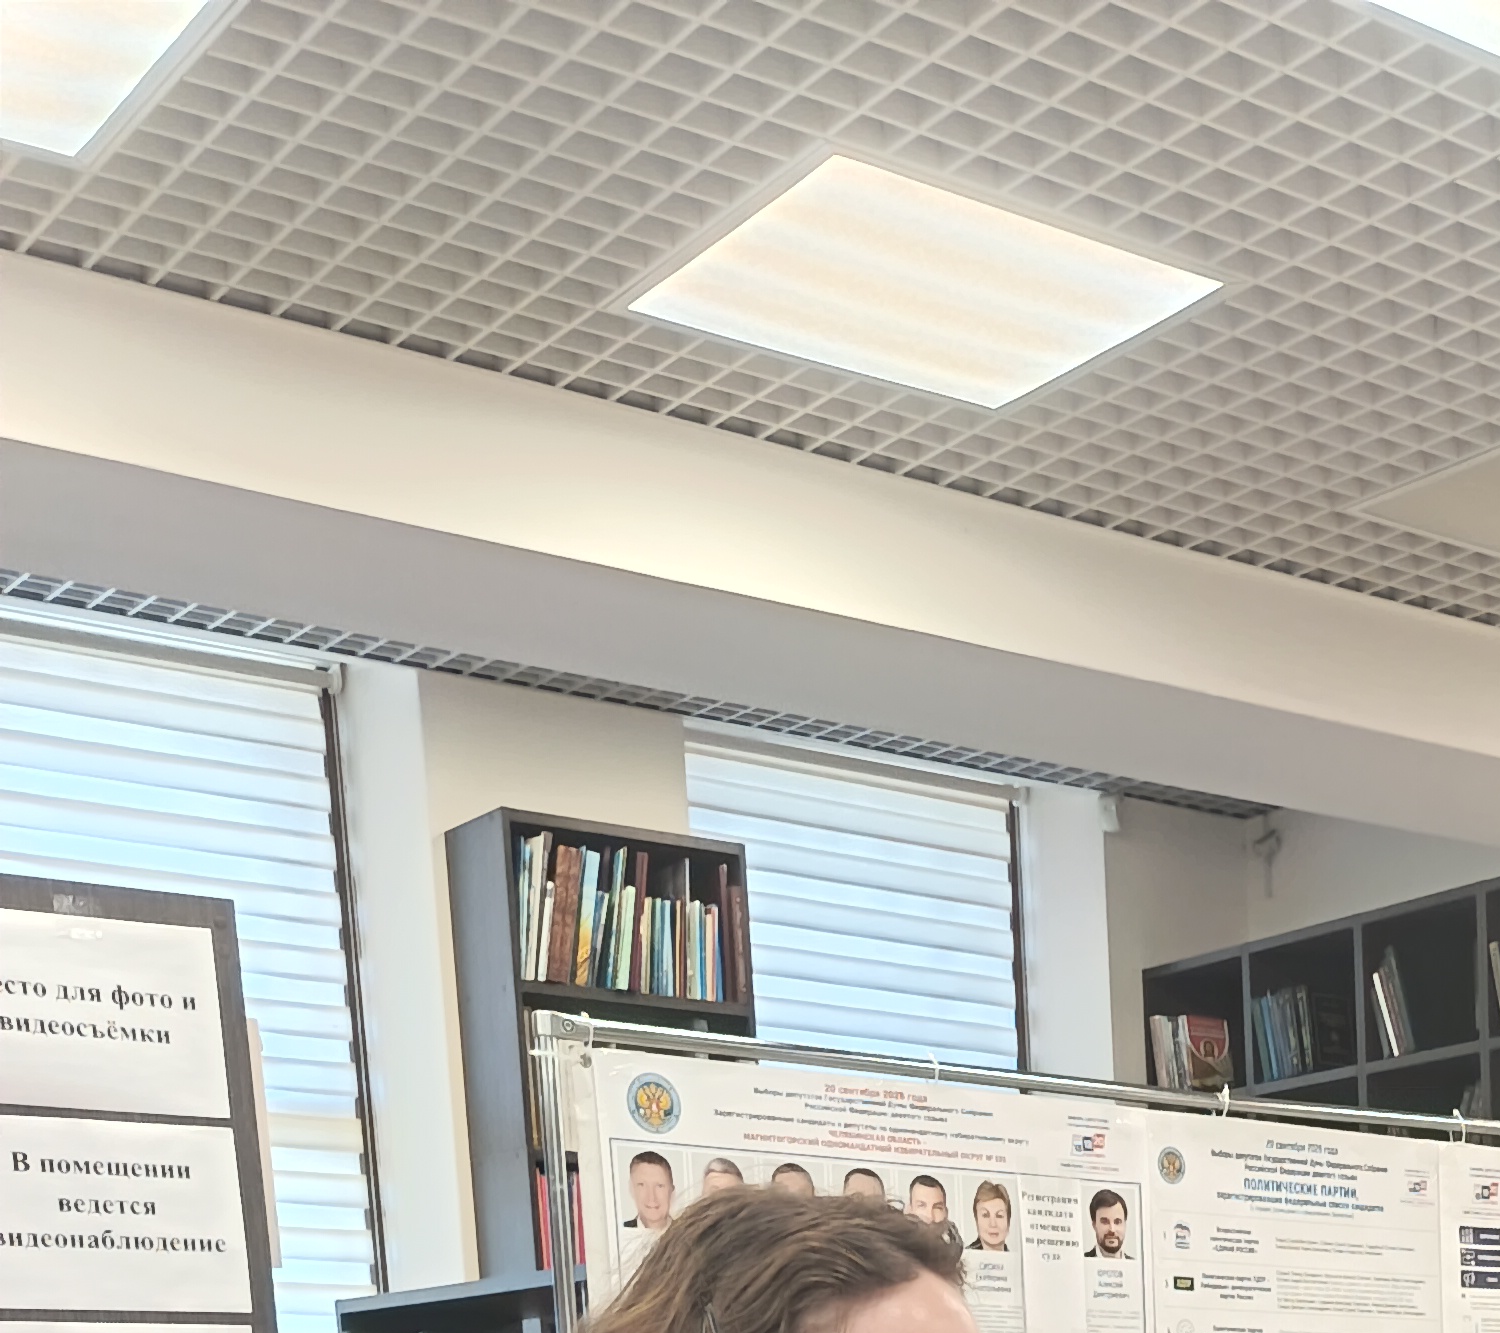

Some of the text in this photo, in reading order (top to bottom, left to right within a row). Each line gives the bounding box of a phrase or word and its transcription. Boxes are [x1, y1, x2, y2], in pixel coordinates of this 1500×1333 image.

[0, 979, 196, 1013] сто для фото и
[0, 1016, 171, 1046] видеосъёмки
[11, 1151, 191, 1179] В помещении
[1243, 1177, 1317, 1196] ПОЛИТИЧЕСКИЕ
[58, 1197, 157, 1217] ведется
